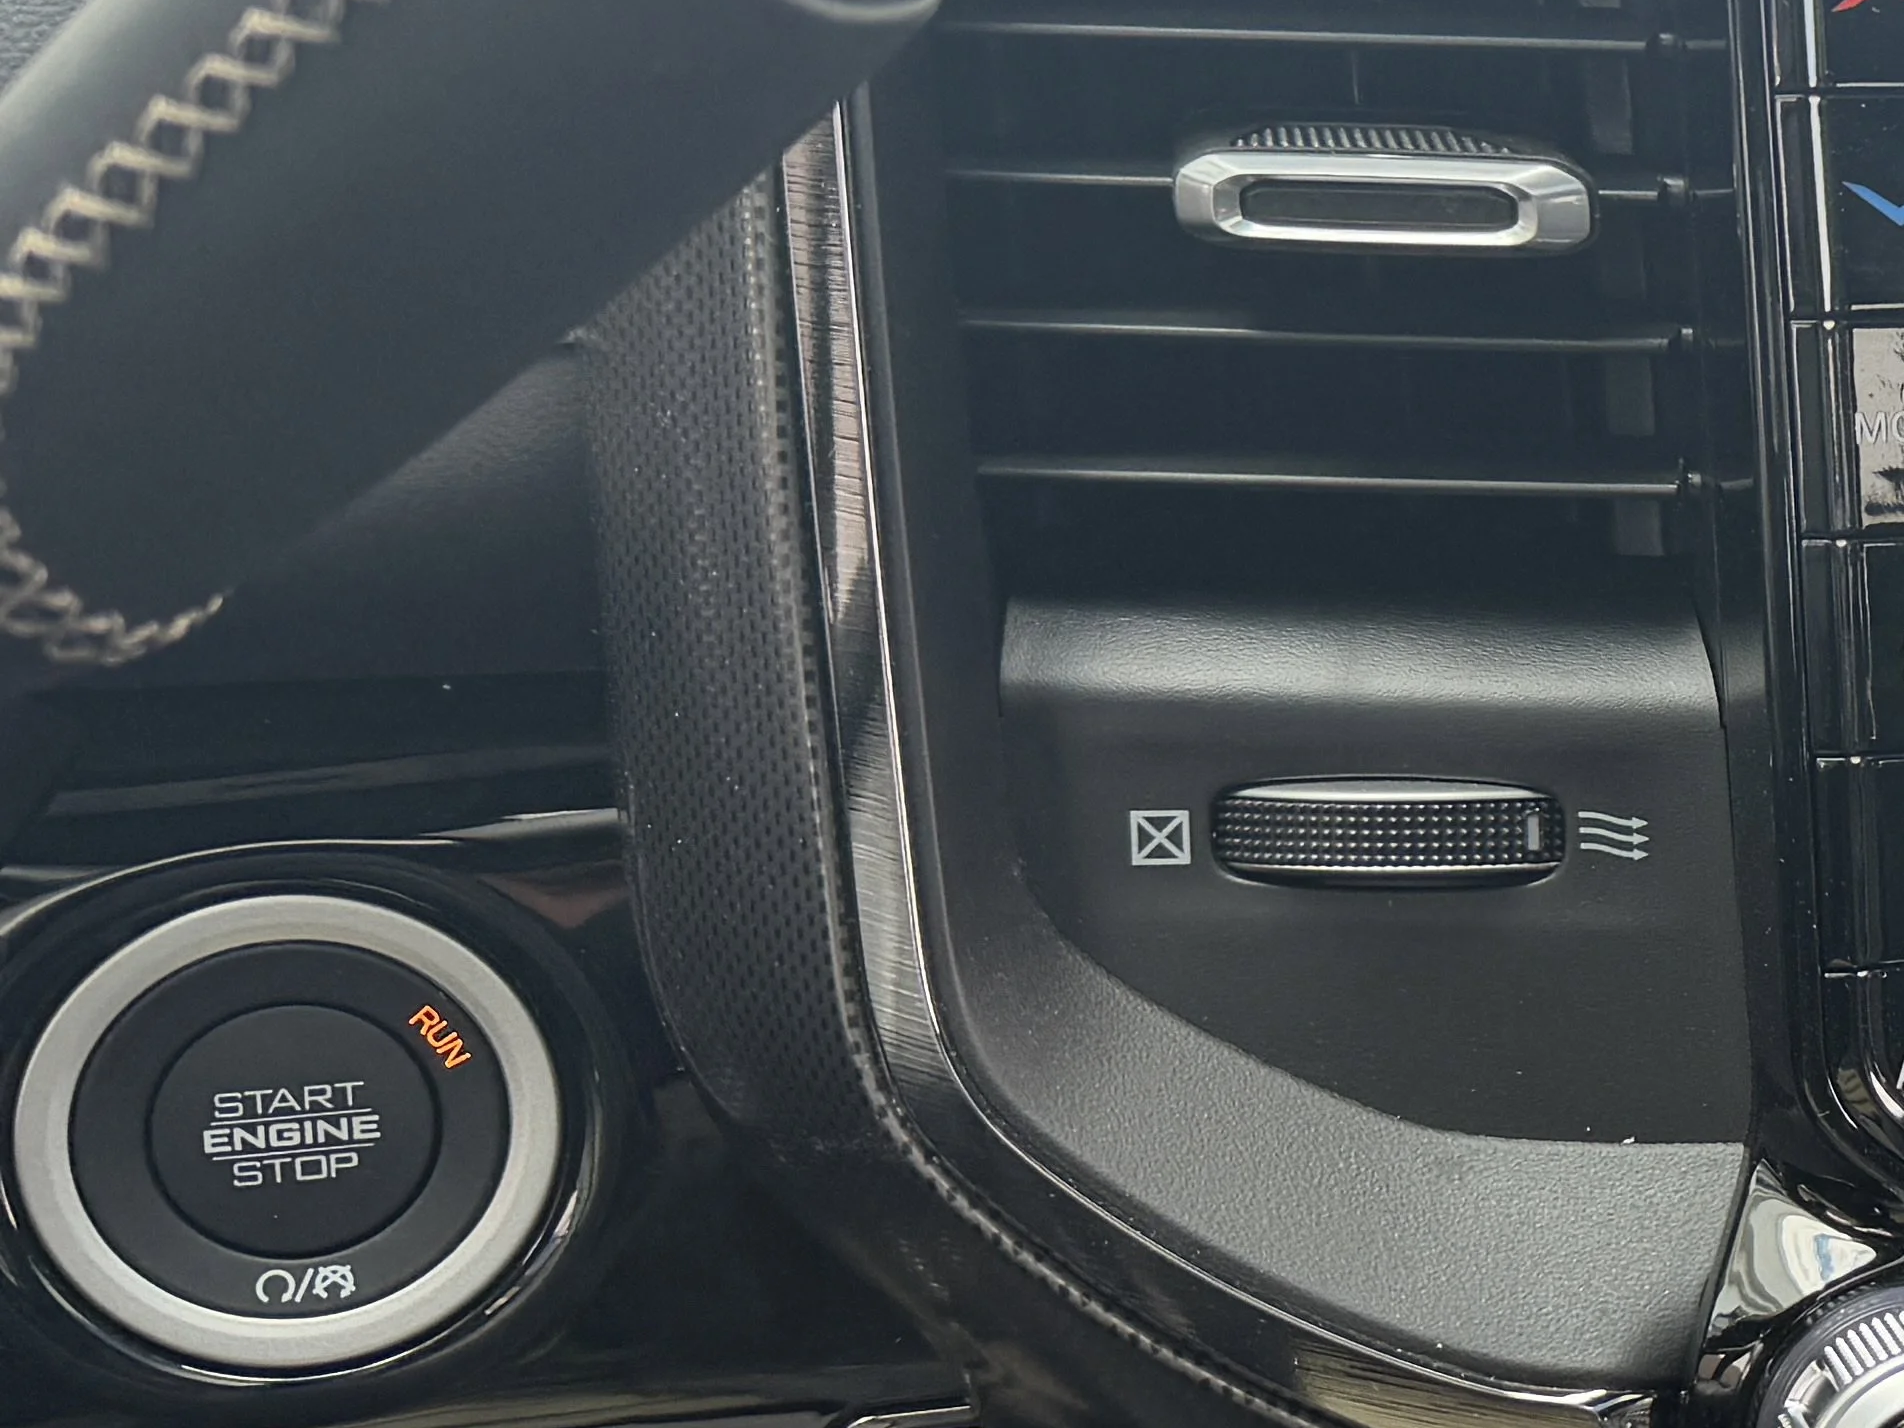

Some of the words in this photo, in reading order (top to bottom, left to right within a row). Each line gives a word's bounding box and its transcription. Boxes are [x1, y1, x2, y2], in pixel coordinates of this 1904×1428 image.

[409, 1004, 471, 1069] RUN
[213, 1081, 364, 1118] START
[202, 1114, 381, 1155] ENGINE
[232, 1151, 359, 1188] STOP
